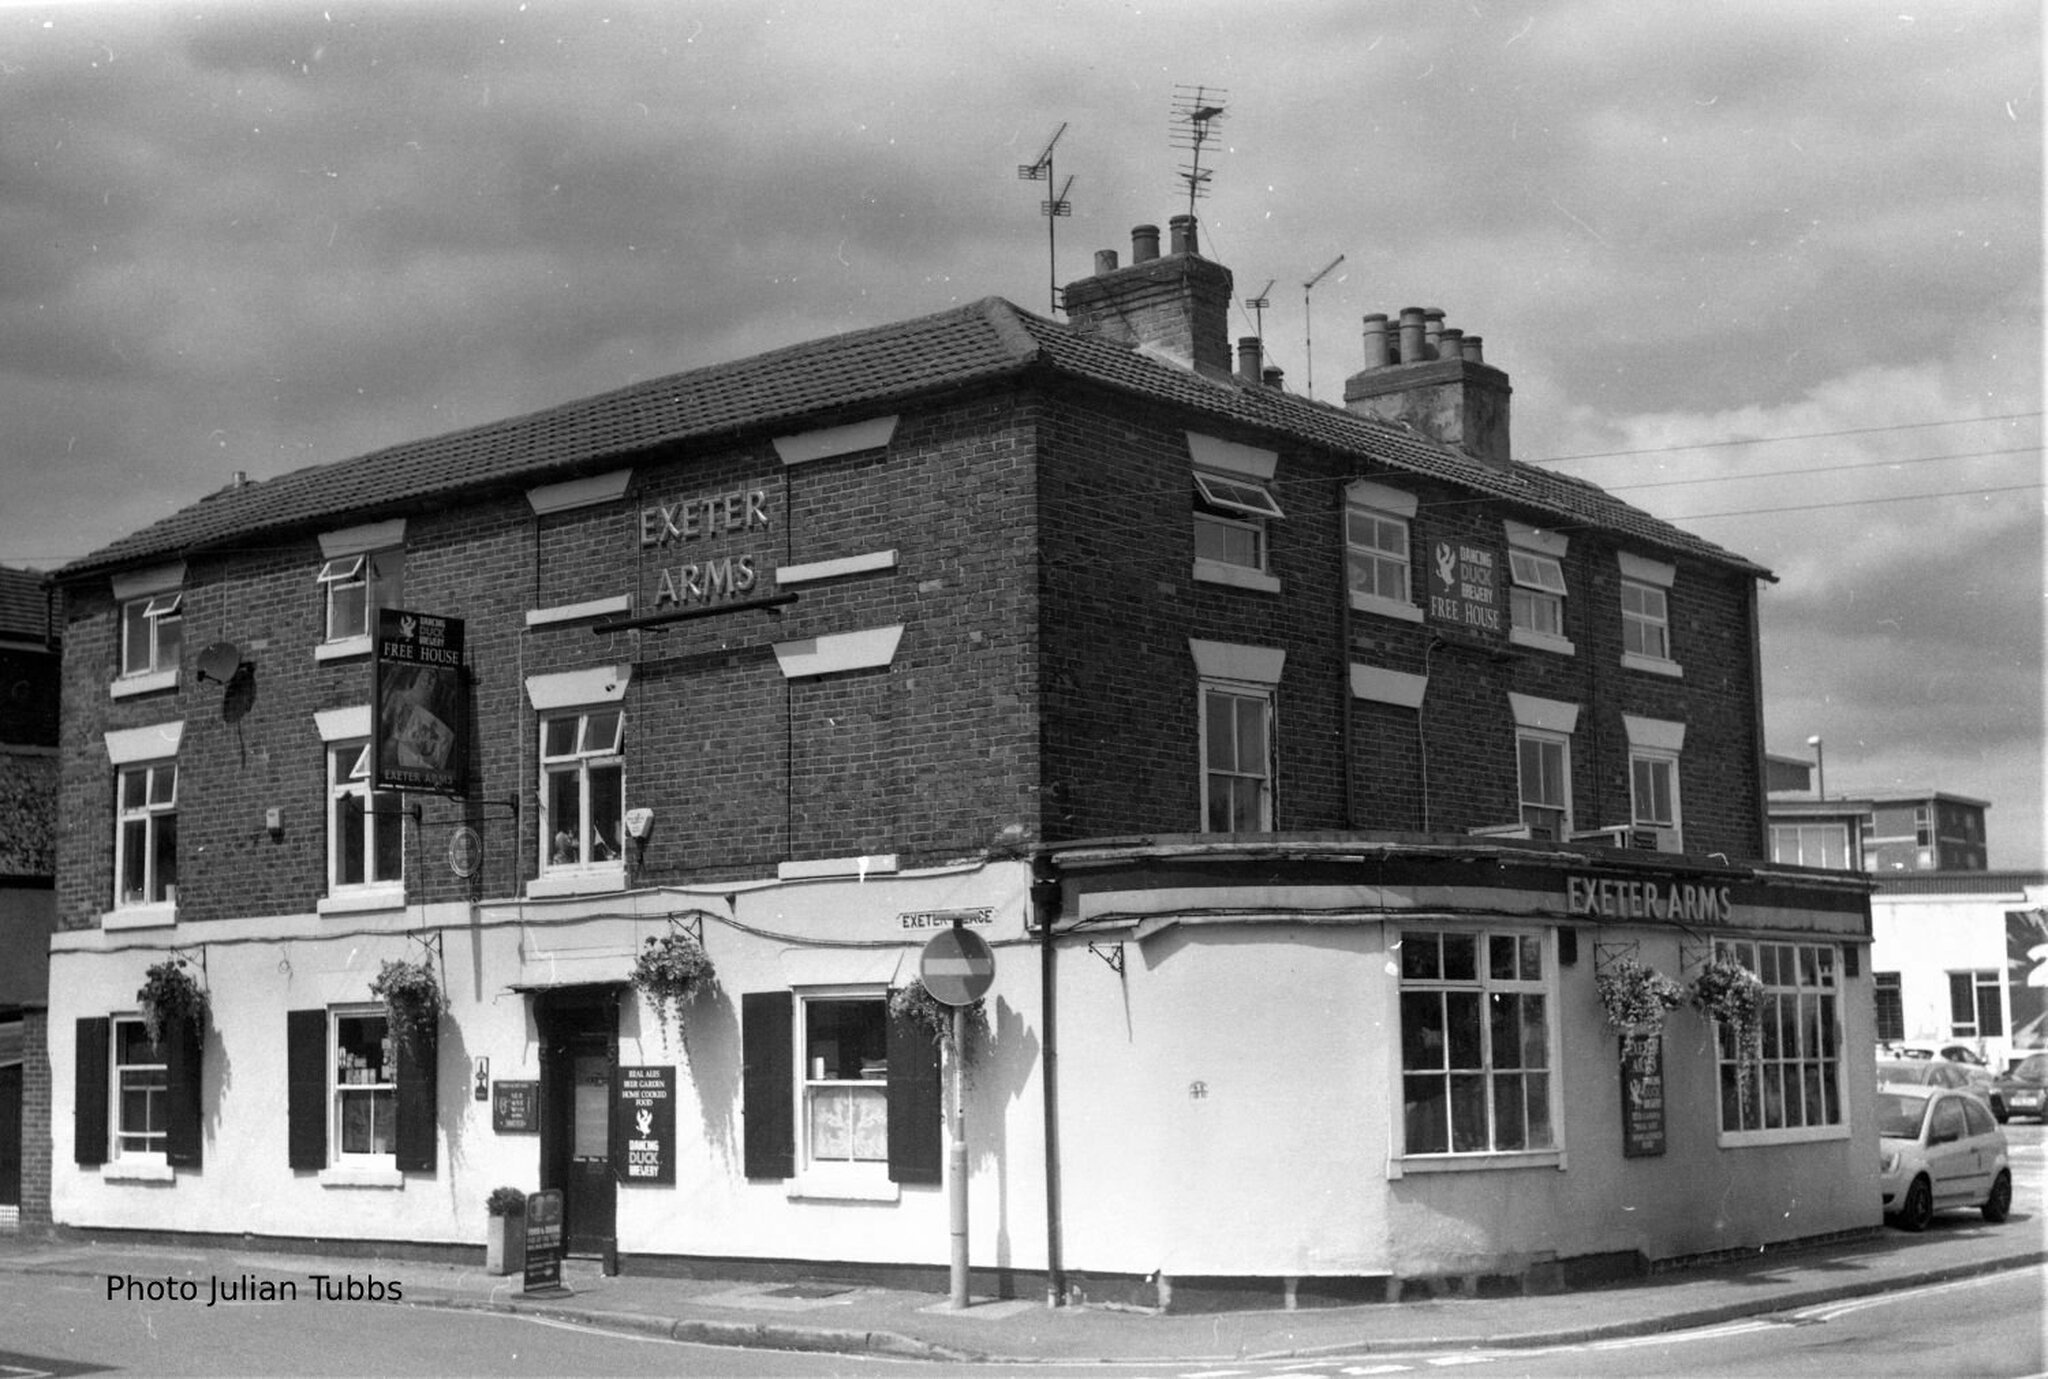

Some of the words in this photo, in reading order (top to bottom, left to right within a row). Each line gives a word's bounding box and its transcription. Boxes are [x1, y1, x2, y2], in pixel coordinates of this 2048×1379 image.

[641, 490, 769, 547] EXETER
[655, 554, 755, 606] ARMS
[1461, 563, 1492, 588] DUCK
[1432, 596, 1459, 620] FREE
[1465, 602, 1499, 630] HOUSE
[385, 642, 413, 659] FREE
[421, 646, 459, 665] HOUSE
[385, 769, 420, 782] EXETER
[1567, 876, 1660, 919] EXETER
[1668, 883, 1732, 921] ARMS
[624, 1080, 638, 1088] BEER
[639, 1080, 665, 1088] GARDEN
[622, 1090, 640, 1098] HOME
[641, 1090, 667, 1098] COOKED
[629, 1140, 659, 1151] DANCING
[629, 1151, 659, 1165] DUCK
[629, 1165, 659, 1177] BREWERY
